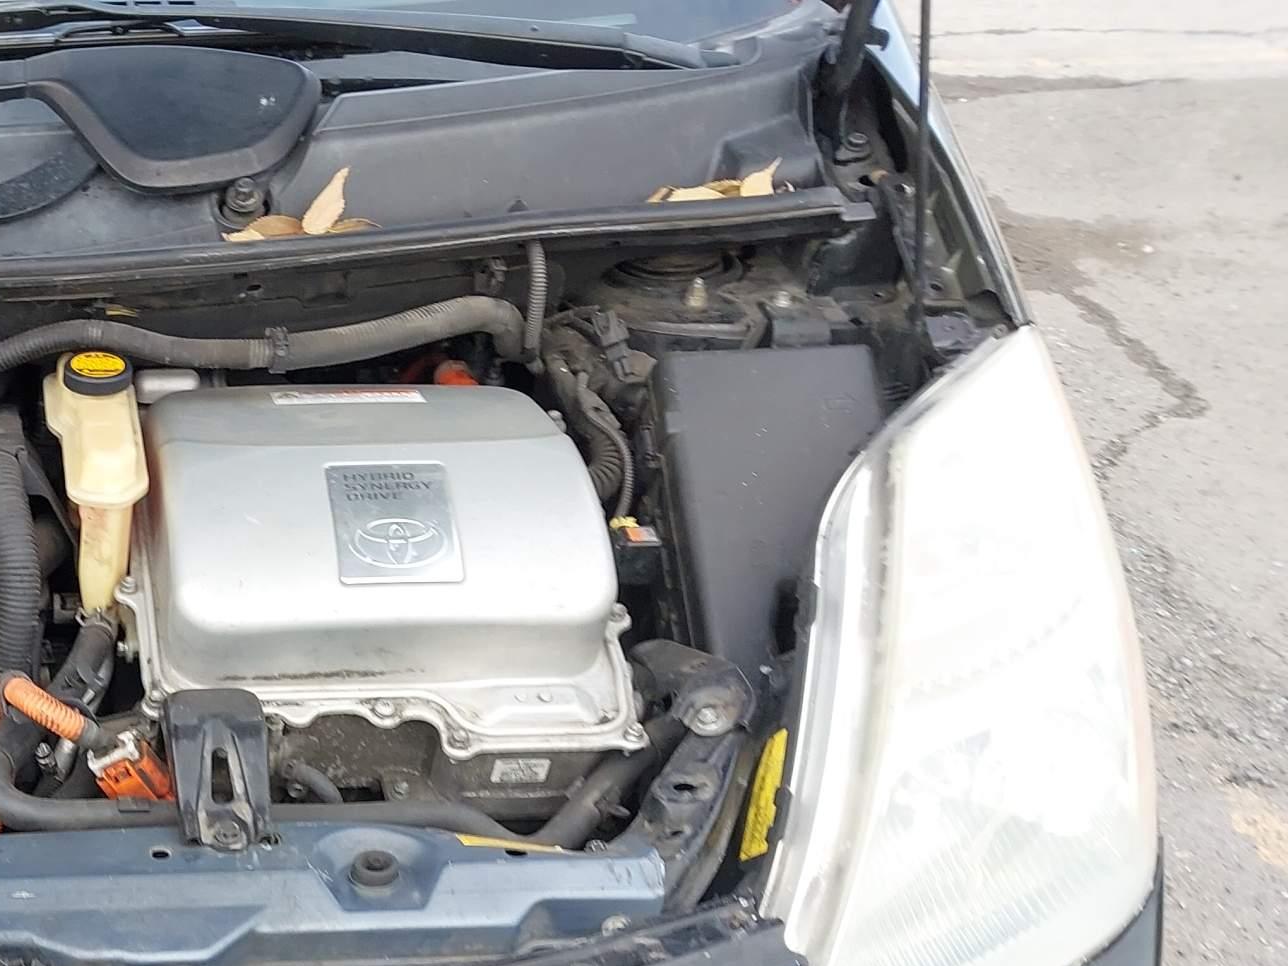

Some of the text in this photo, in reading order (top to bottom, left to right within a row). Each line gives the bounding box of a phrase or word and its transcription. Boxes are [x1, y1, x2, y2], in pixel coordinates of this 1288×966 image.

[343, 471, 415, 481] HYBRID
[343, 480, 431, 491] SYNERGY
[345, 491, 402, 501] DRIVE
